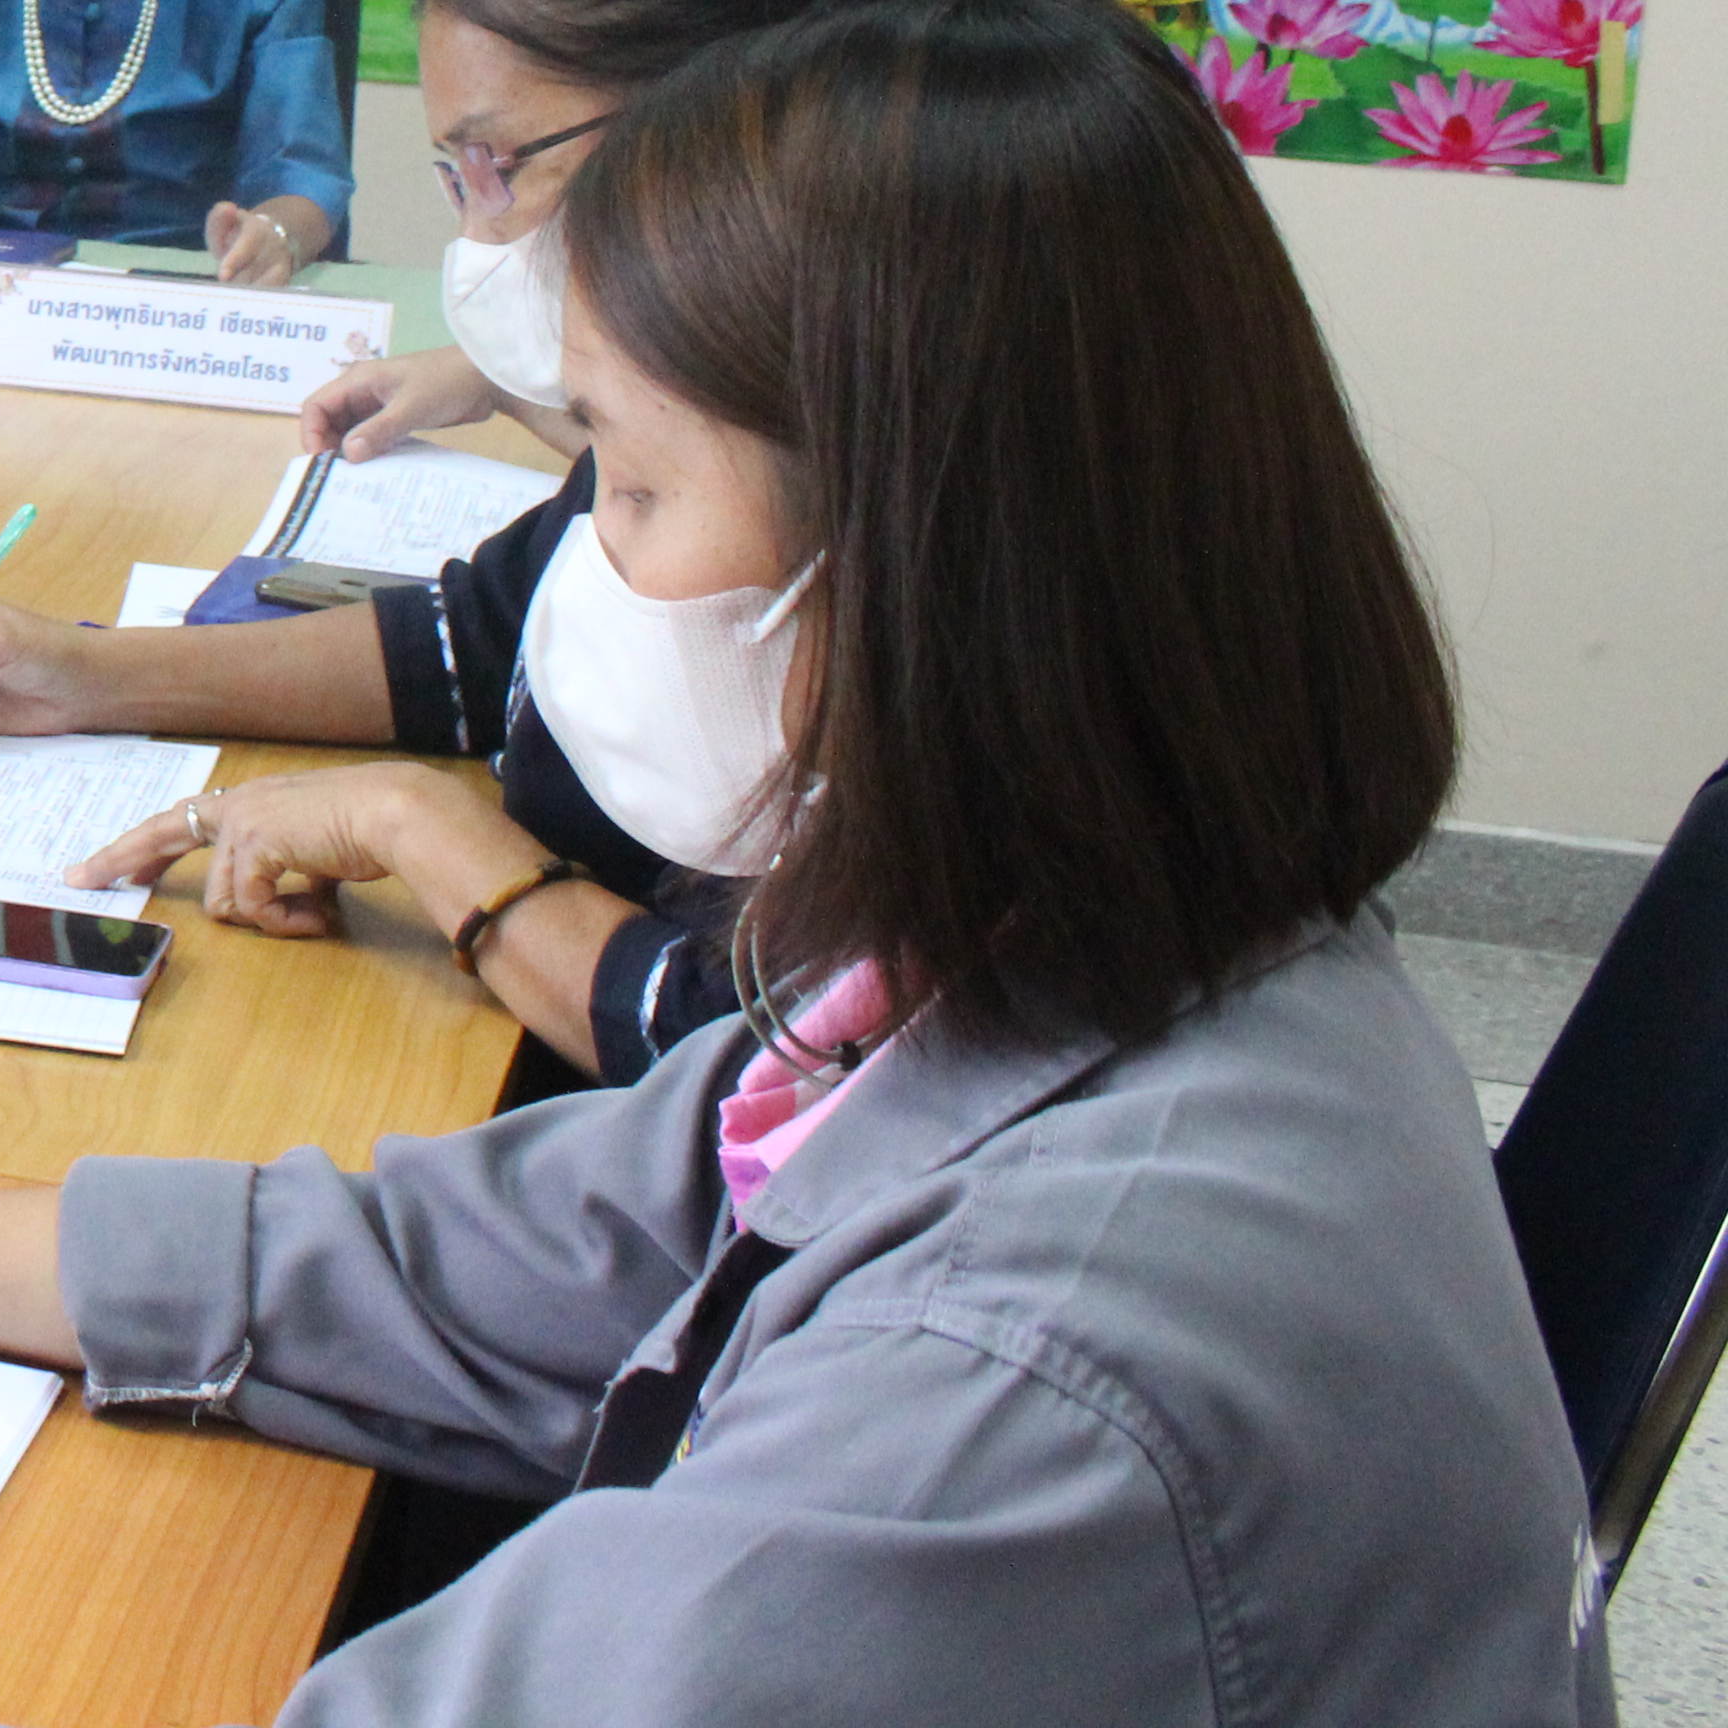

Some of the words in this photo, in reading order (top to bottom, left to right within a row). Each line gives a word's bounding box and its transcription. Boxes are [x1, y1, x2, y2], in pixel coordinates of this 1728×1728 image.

[52, 338, 291, 383] พัฒนาการจังหวัดยโสธร
